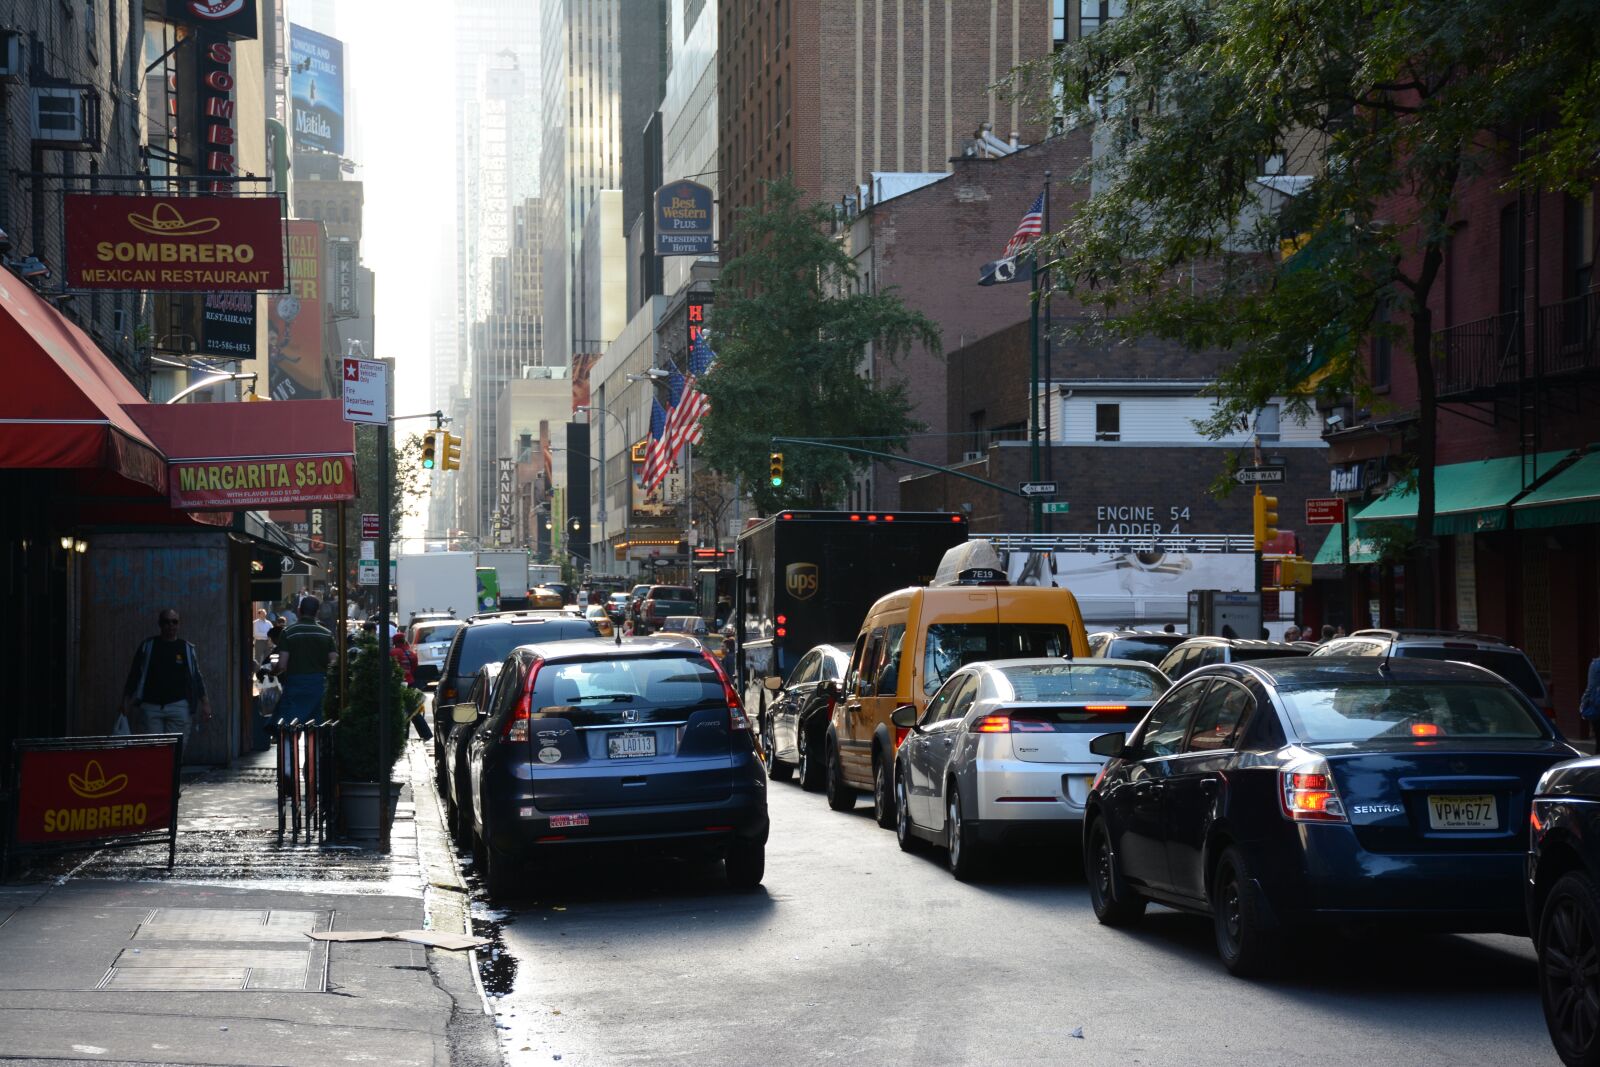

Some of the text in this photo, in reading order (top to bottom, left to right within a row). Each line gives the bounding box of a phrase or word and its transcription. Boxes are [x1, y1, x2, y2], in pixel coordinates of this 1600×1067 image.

[296, 108, 331, 139] Matilda
[671, 197, 696, 208] Best
[662, 207, 706, 218] Western
[661, 235, 709, 243] PRESIDENT
[96, 242, 254, 263] SOMBRERO
[672, 244, 698, 252] HOTEL
[82, 268, 270, 284] MEXICAN RESTAURANT
[340, 260, 350, 312] KERR
[206, 311, 252, 325] RESTAURANT
[346, 396, 375, 406] Department
[179, 460, 344, 491] MARGARITA $5.00
[1239, 473, 1256, 481] ONE
[1331, 465, 1358, 492] Brazil
[500, 460, 511, 527] MANNY'S
[1051, 503, 1057, 512] 8
[1097, 506, 1190, 521] ENGINE 54
[1097, 523, 1181, 535] LADDER 4
[972, 570, 994, 579] 7E19
[787, 573, 817, 594] ups
[1353, 805, 1400, 814] SENTRA
[44, 803, 147, 833] SOMBRERO
